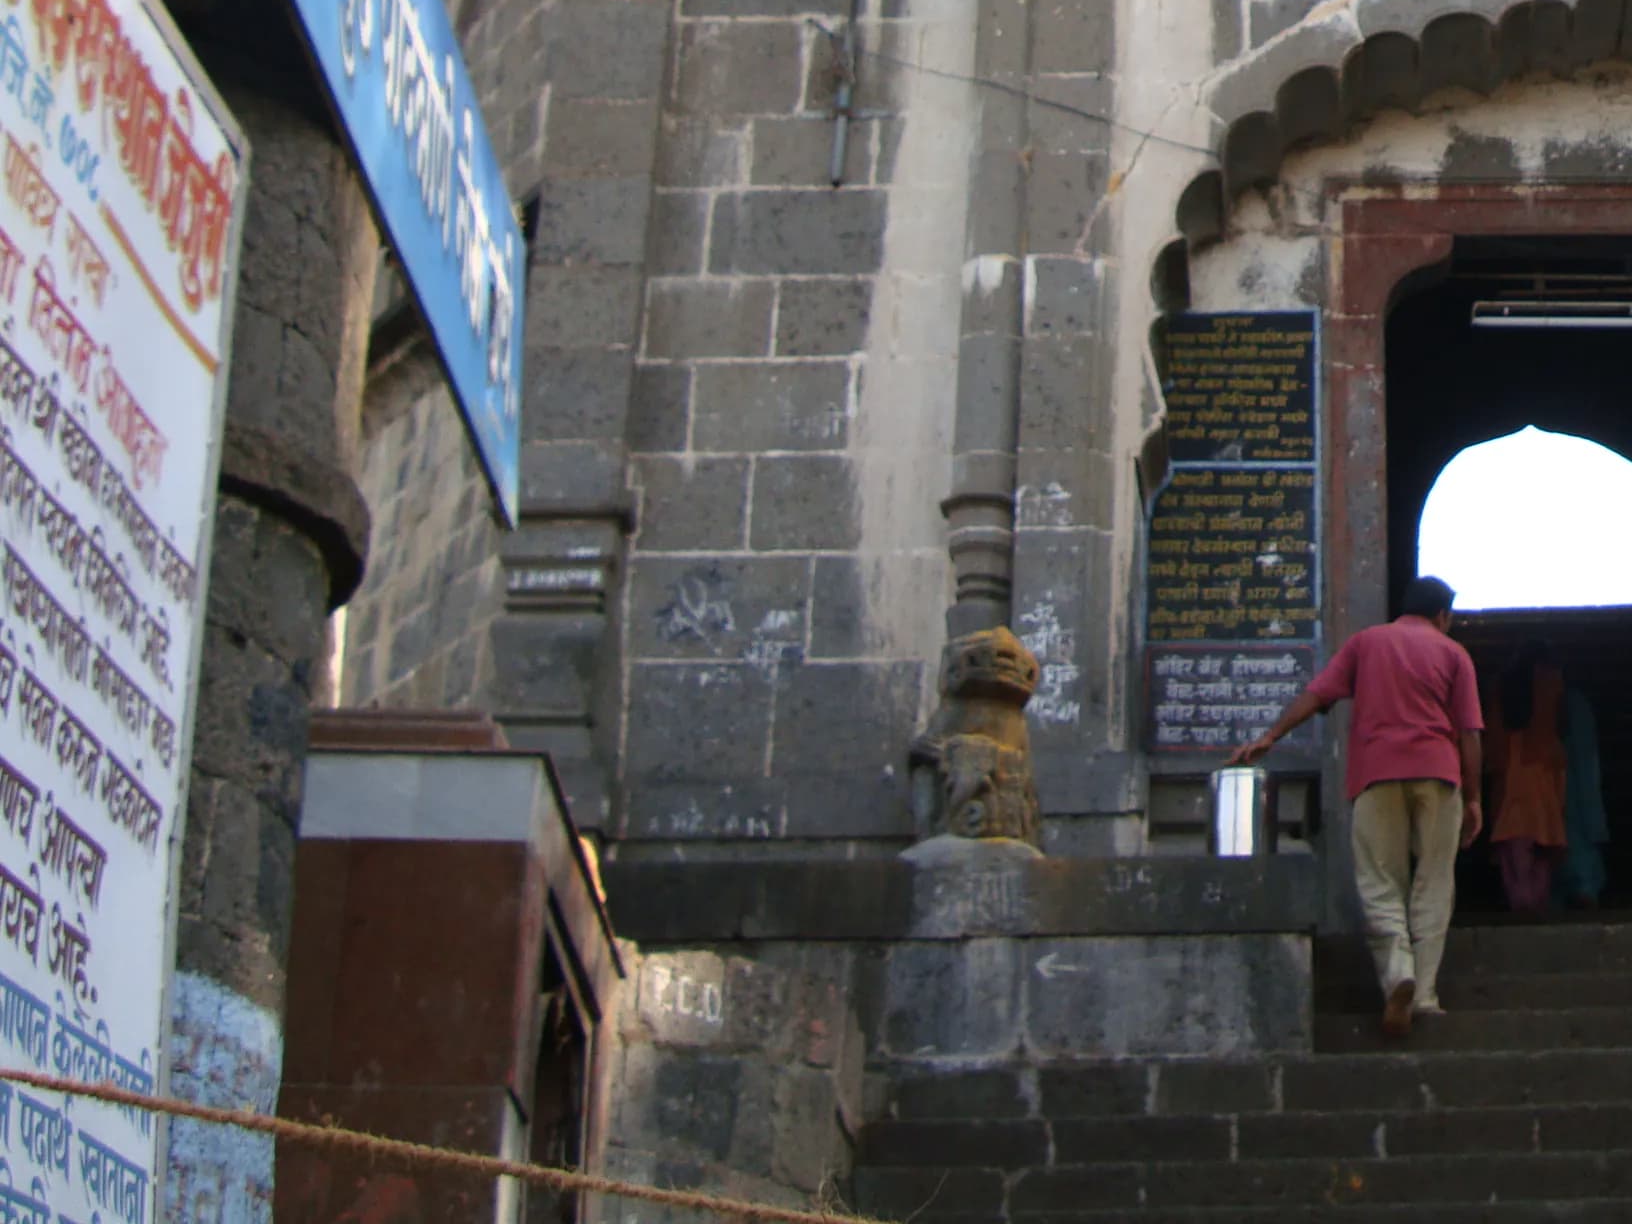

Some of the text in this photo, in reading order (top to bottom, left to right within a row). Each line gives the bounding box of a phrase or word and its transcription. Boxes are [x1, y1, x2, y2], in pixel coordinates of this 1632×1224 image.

[158, 87, 232, 314] जेजुरी
[40, 789, 108, 913] आपल्या
[48, 900, 98, 1020] आहे.
[17, 1089, 73, 1189] पदार्थ
